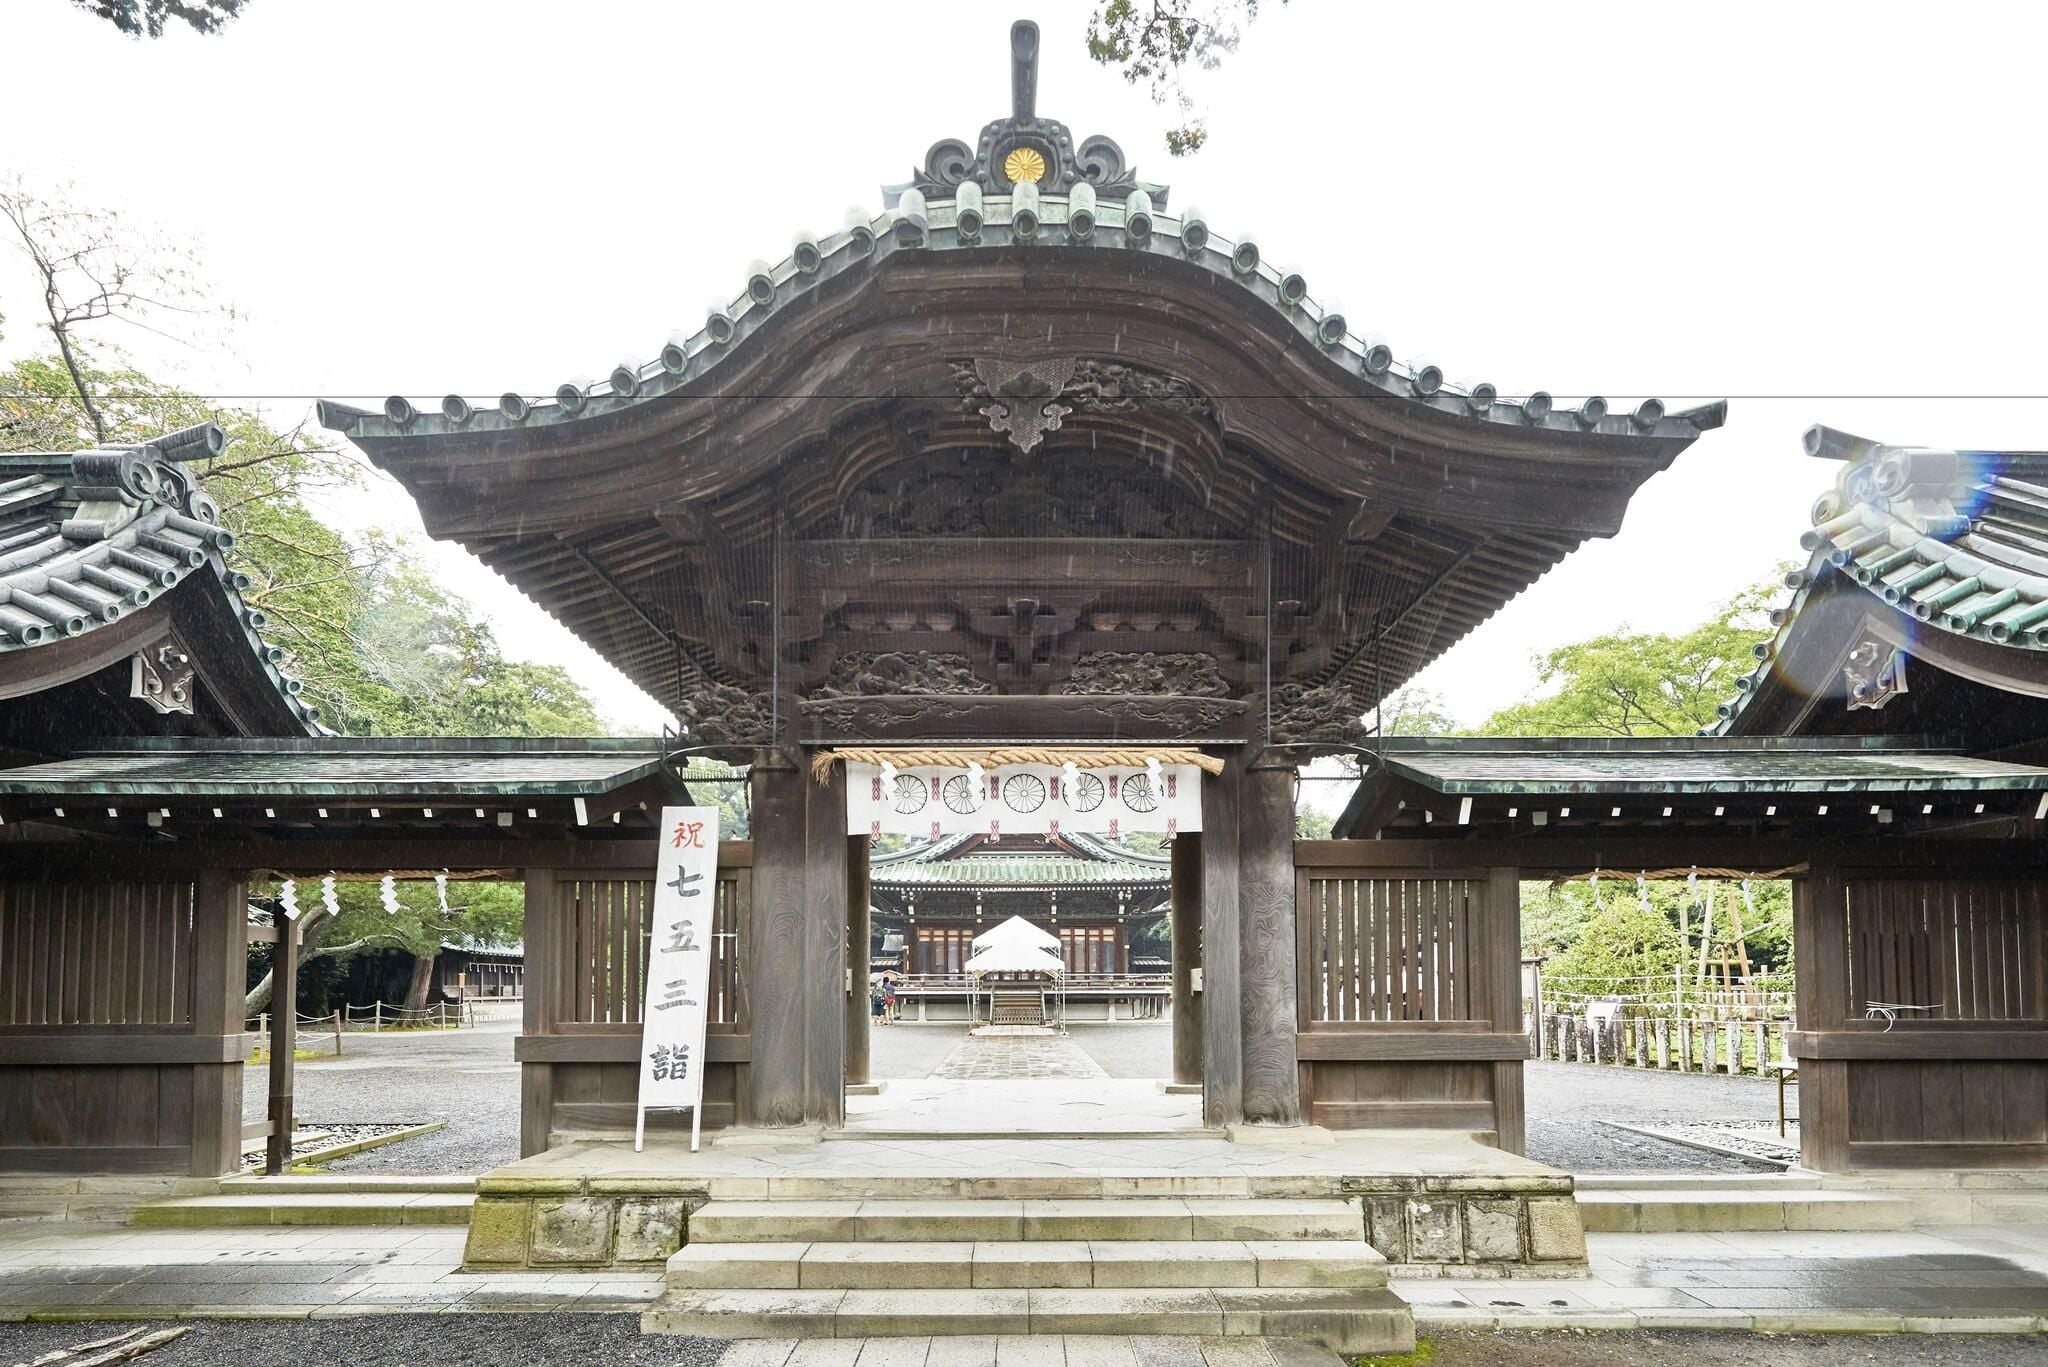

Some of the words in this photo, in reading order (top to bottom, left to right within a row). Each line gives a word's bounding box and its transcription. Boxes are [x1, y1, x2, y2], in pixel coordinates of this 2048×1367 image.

[649, 821, 705, 1082] 祝七五三詣
